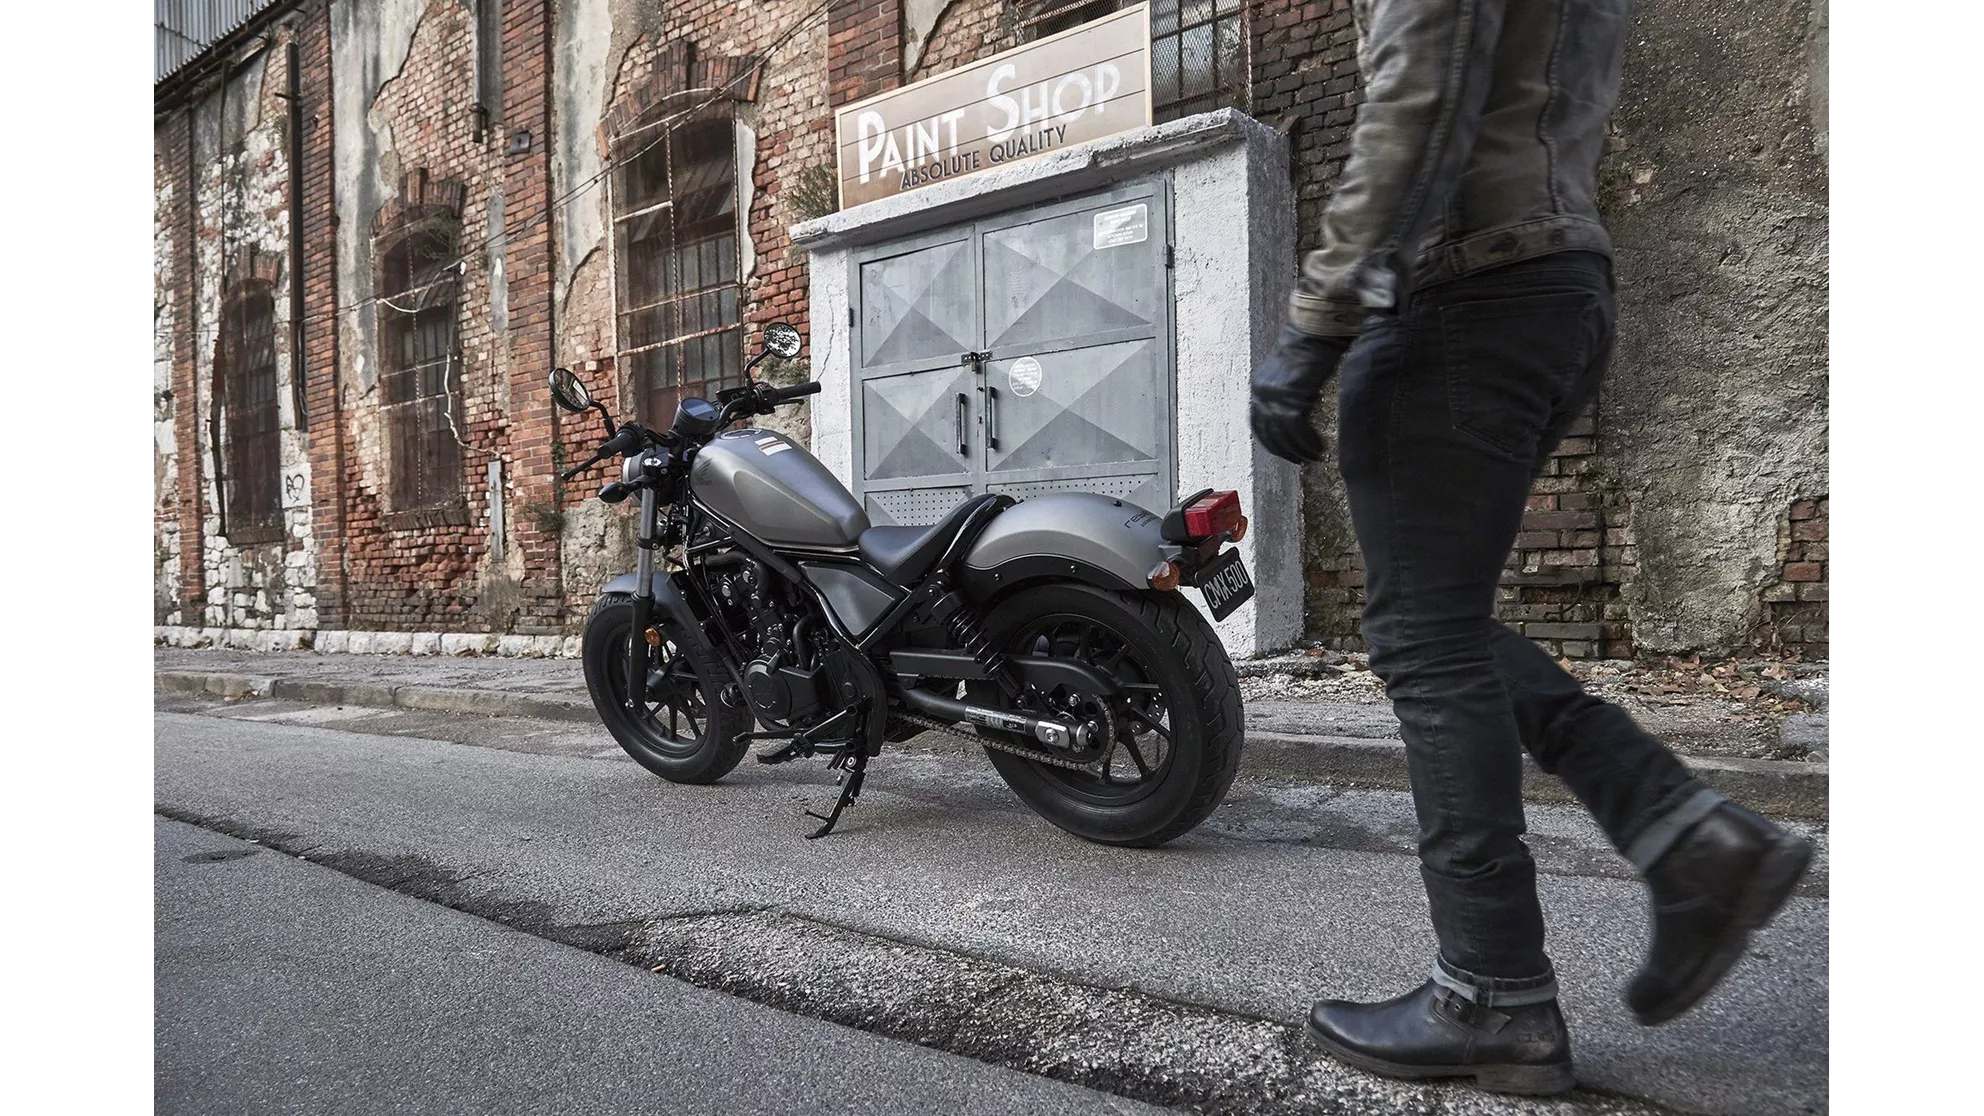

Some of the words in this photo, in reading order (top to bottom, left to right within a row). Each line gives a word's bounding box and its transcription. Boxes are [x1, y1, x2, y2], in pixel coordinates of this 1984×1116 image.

[857, 108, 966, 185] PAINT
[986, 62, 1121, 144] SHOP
[900, 150, 981, 190] ABSOLUTE
[989, 124, 1067, 163] QUALITY
